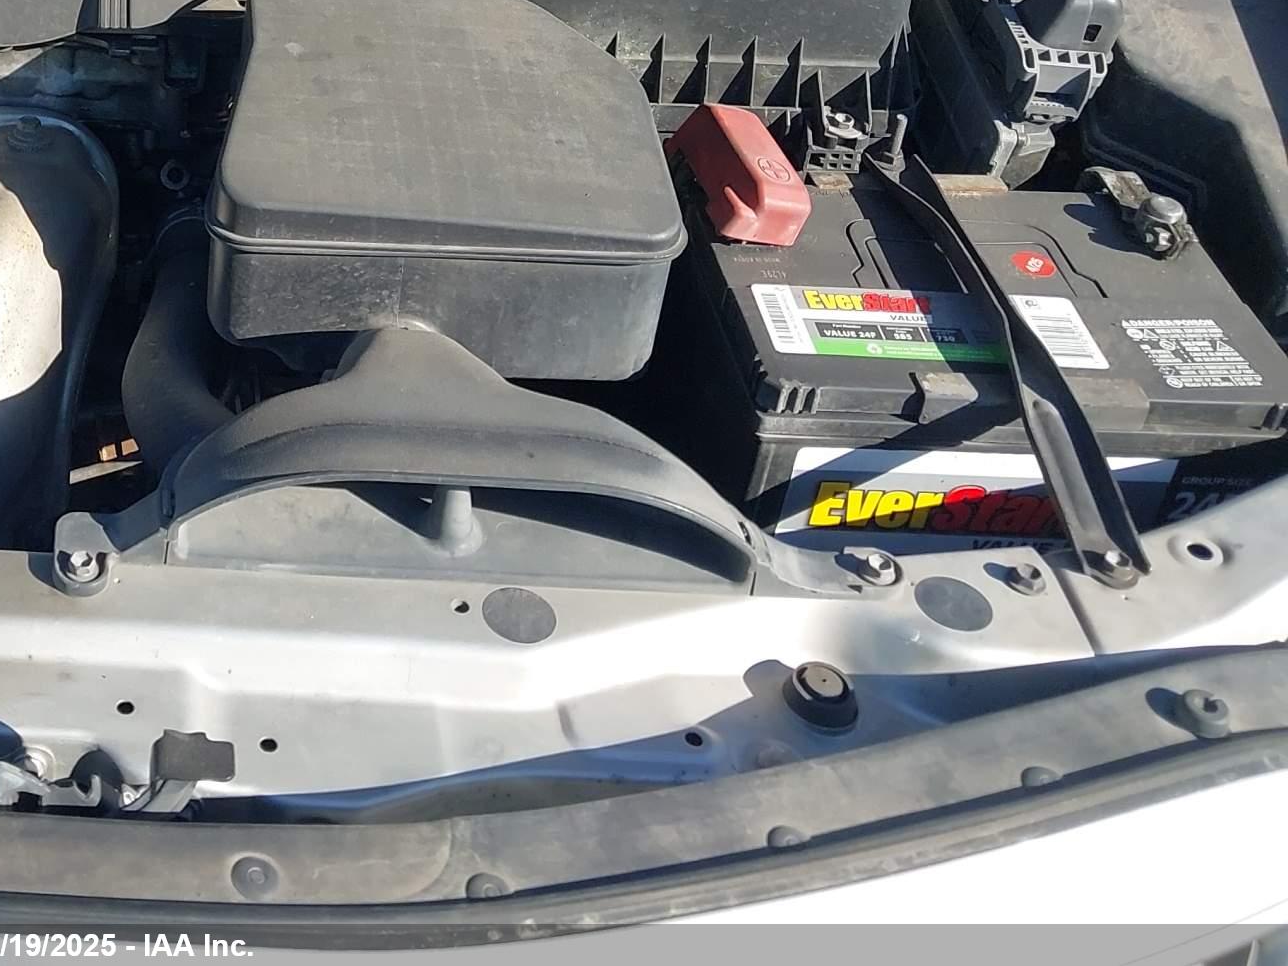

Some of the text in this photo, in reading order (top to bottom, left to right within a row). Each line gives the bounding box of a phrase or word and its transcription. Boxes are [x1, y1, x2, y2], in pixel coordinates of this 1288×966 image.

[802, 289, 931, 314] EverStart
[889, 314, 932, 325] VALUE
[824, 329, 857, 338] VALUE
[808, 481, 1065, 532] EverStar
